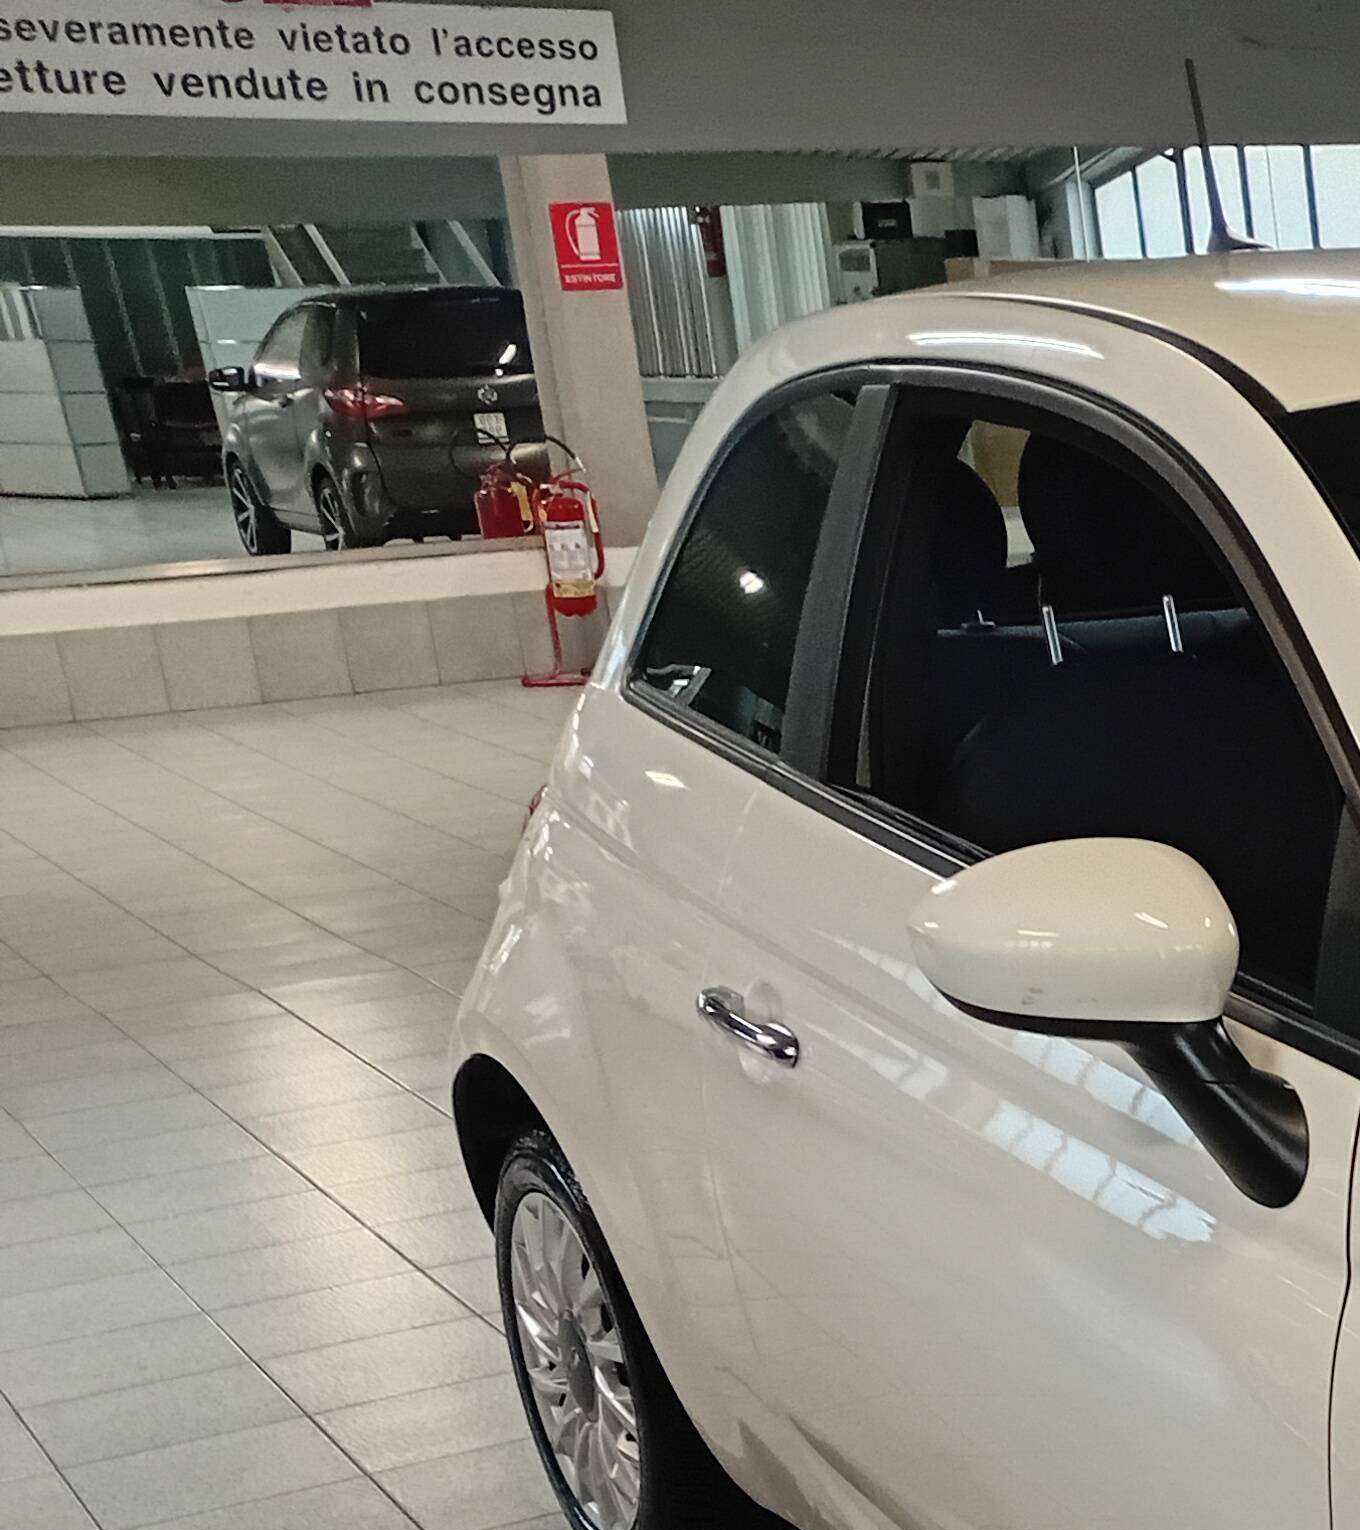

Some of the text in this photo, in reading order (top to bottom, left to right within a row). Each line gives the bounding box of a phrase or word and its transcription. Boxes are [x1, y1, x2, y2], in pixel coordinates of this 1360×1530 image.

[0, 17, 598, 60] severamente vietato l'accesso
[152, 68, 328, 101] vendute
[352, 71, 389, 102] in
[414, 79, 601, 115] consegna
